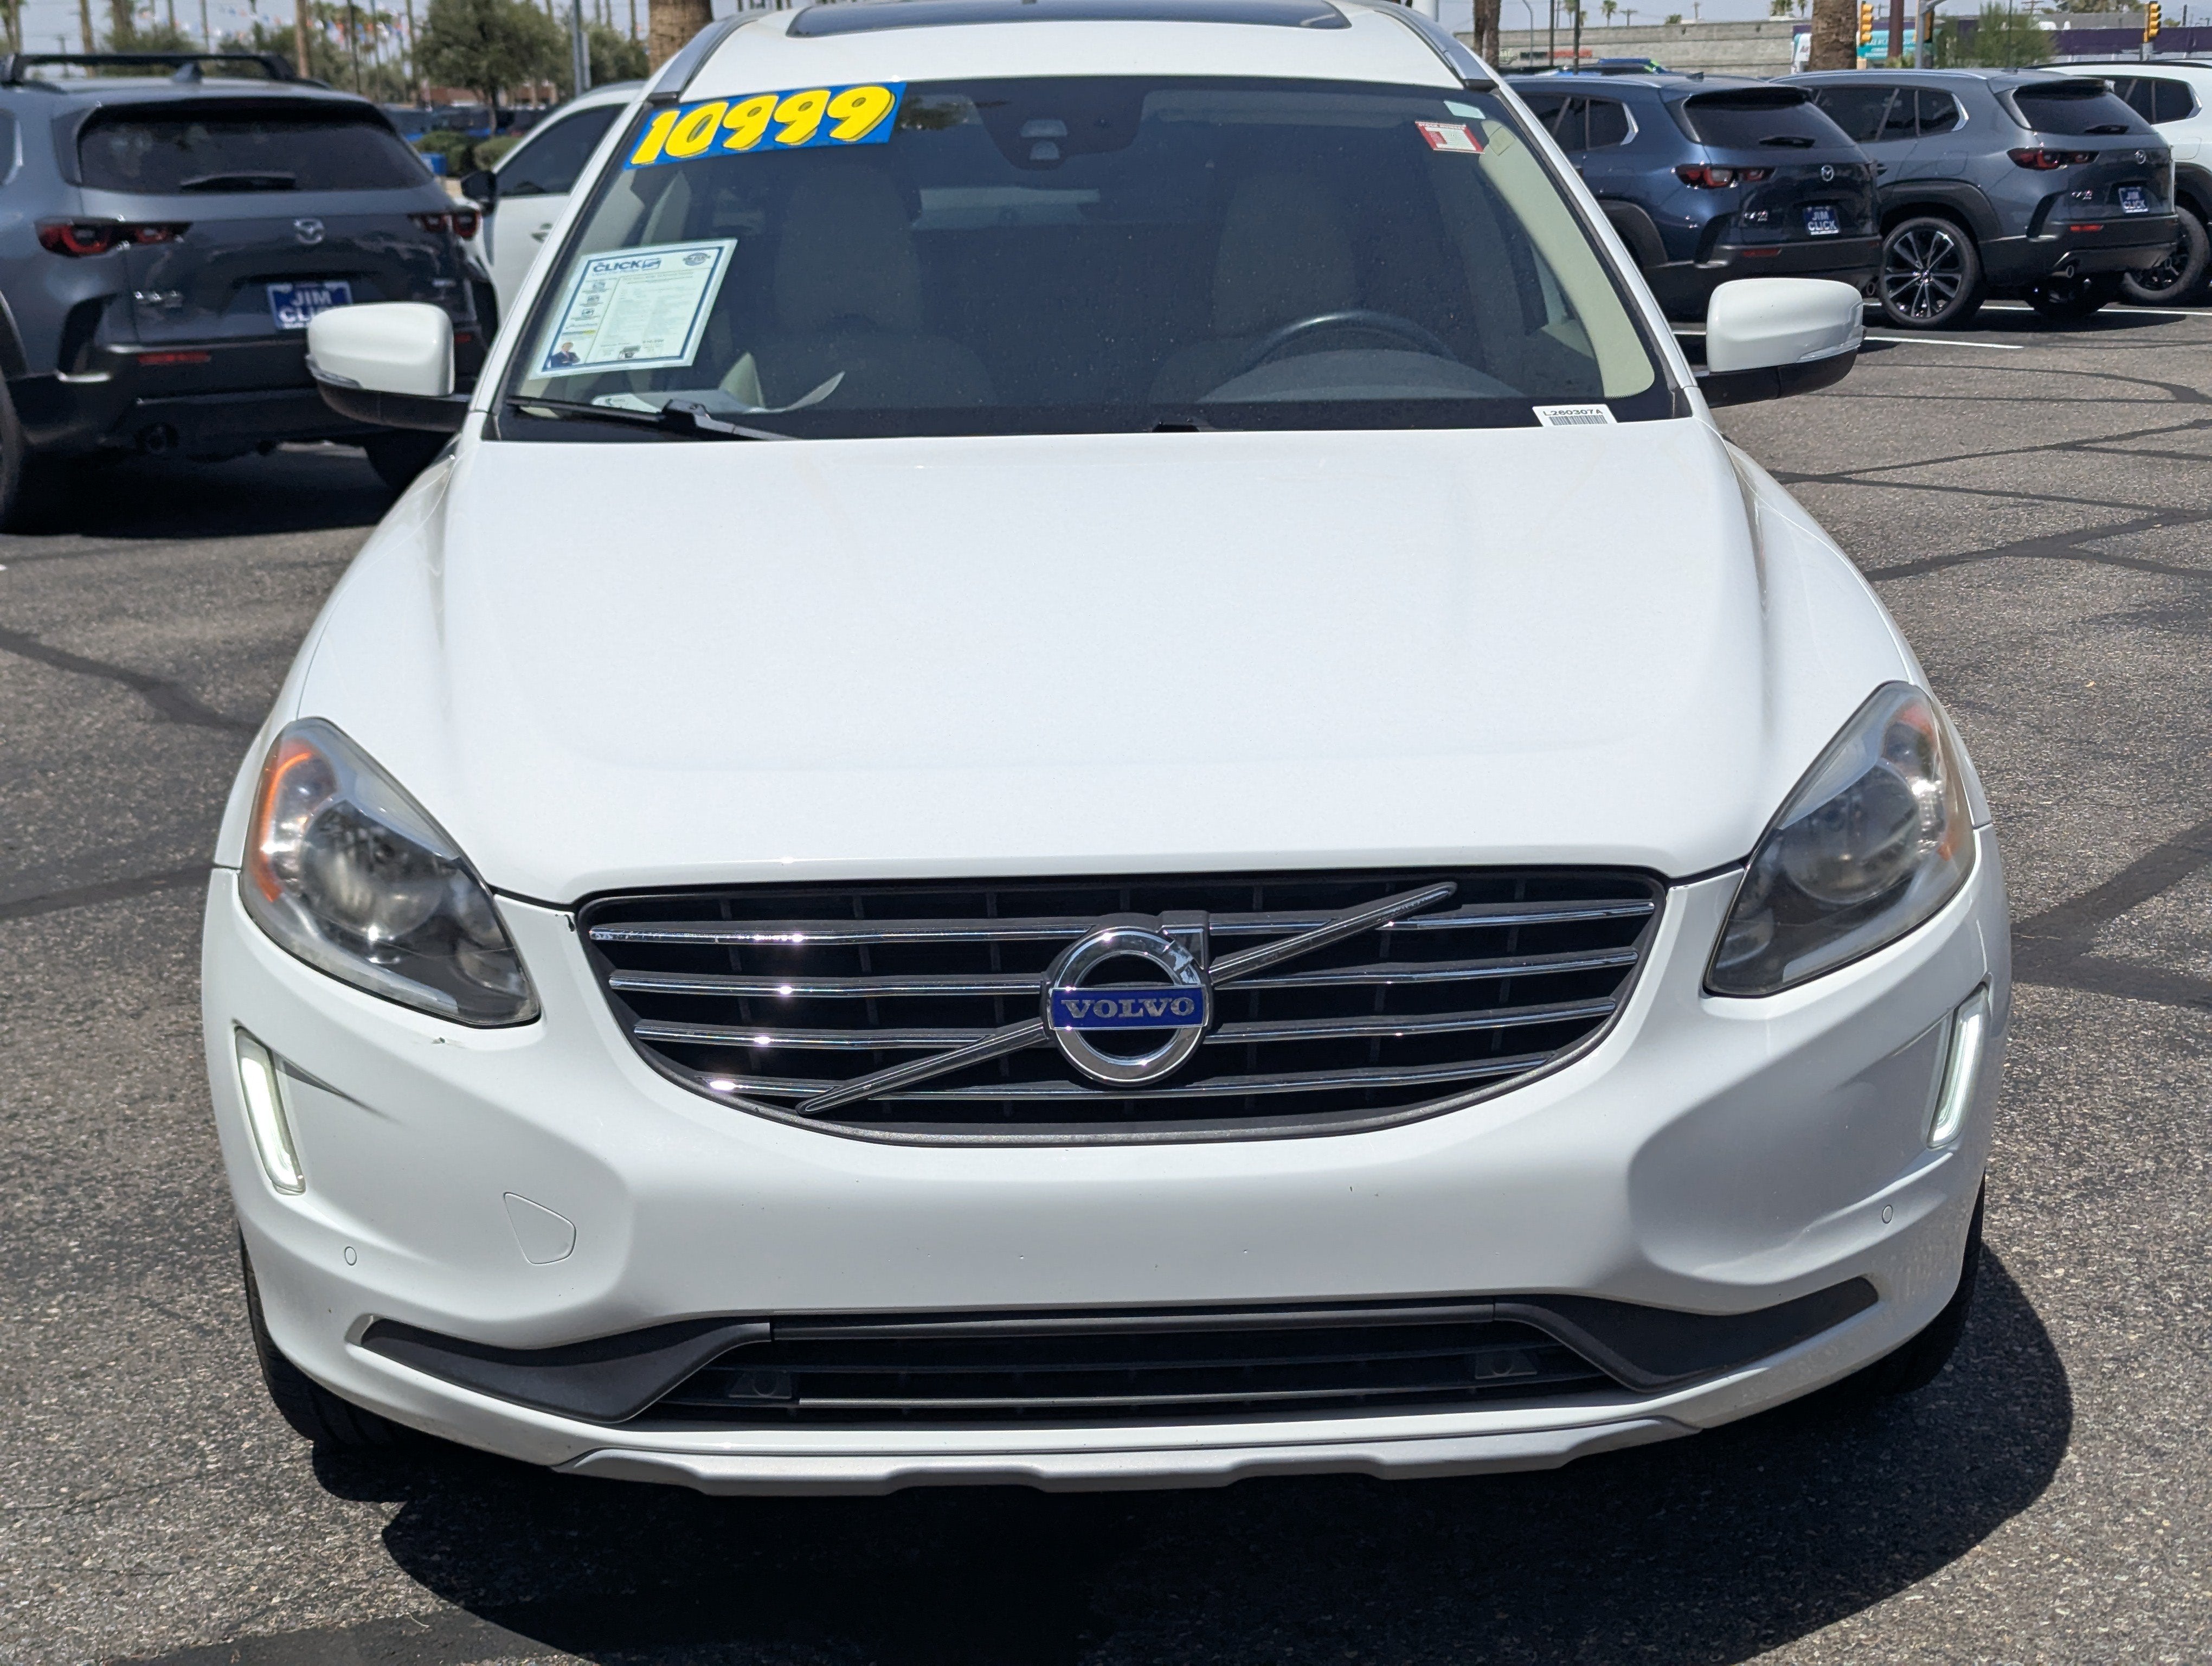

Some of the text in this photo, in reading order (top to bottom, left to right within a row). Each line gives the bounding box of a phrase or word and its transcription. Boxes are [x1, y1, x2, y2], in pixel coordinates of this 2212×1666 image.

[631, 86, 896, 165] 10999
[1812, 211, 1829, 221] JIM
[1808, 220, 1837, 231] CLICK
[593, 260, 643, 272] CLICK
[290, 290, 333, 306] JIM
[1061, 997, 1195, 1018] VOLVO
